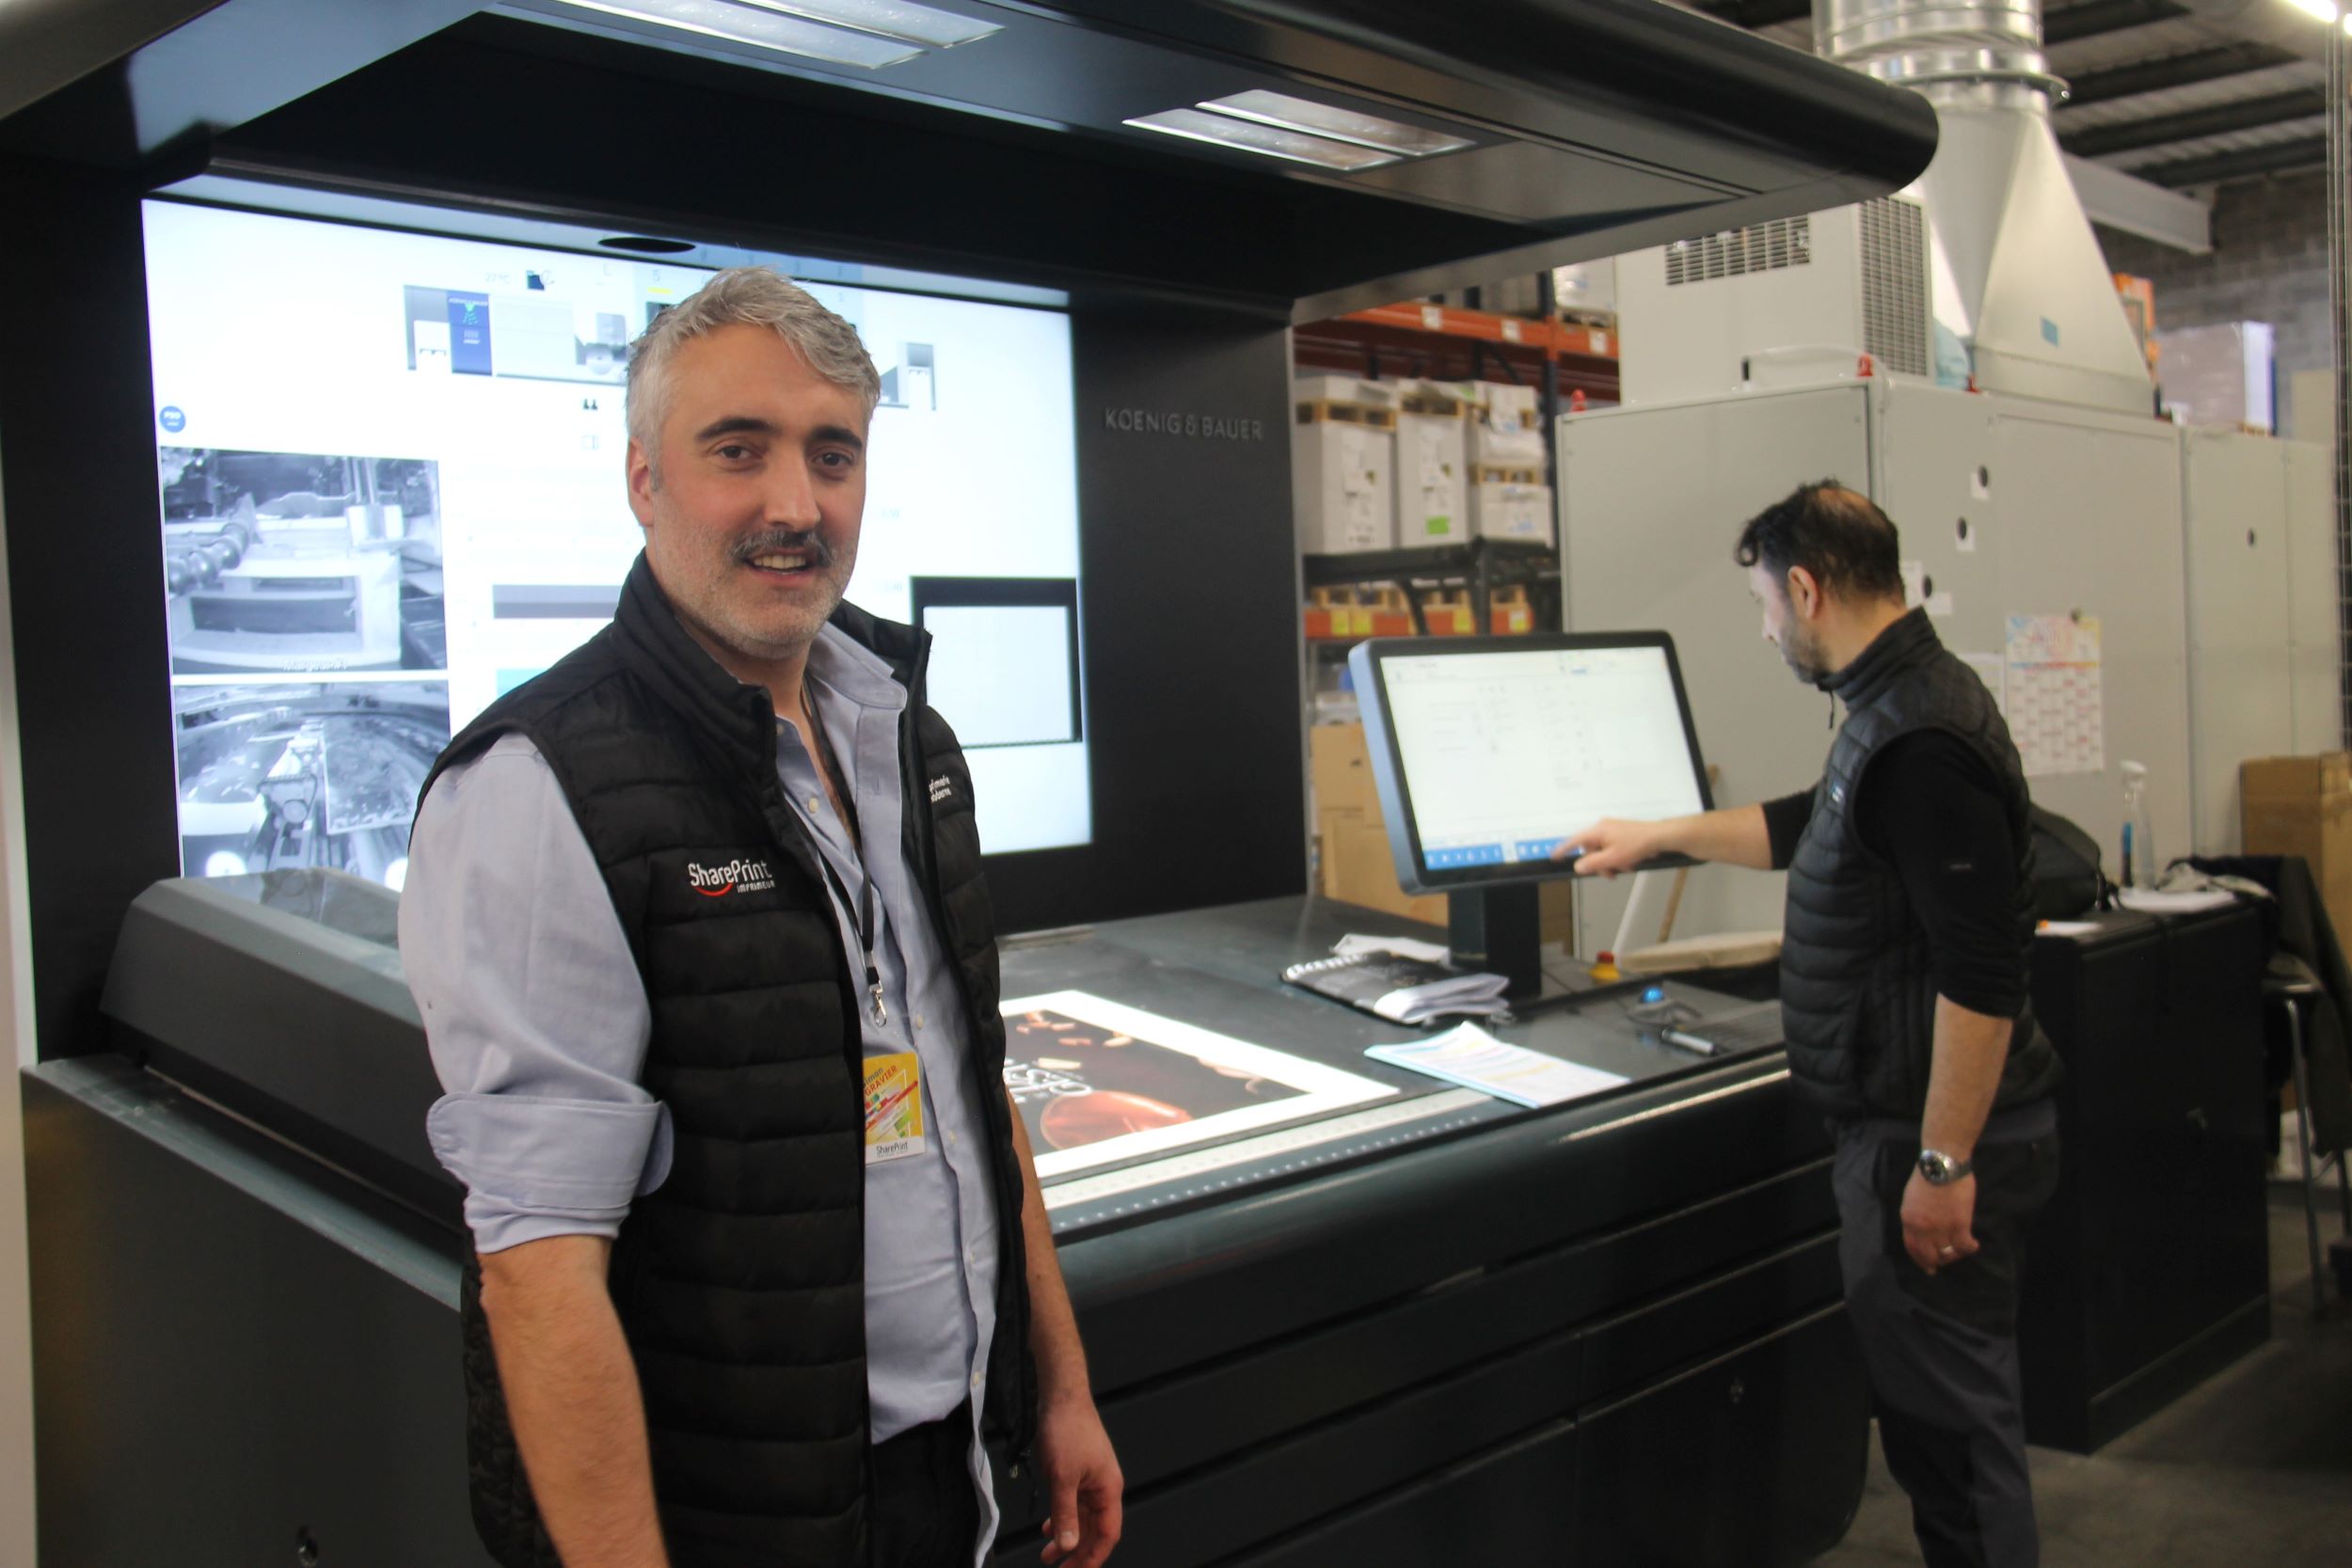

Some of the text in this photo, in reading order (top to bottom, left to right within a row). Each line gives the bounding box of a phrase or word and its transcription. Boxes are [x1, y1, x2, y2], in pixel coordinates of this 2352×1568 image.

[1105, 408, 1181, 435] KOENIG
[1201, 416, 1263, 440] BAUER
[688, 859, 772, 886] SharePrint
[865, 1065, 898, 1096] GRAVIER
[876, 1142, 908, 1153] SharePrint
